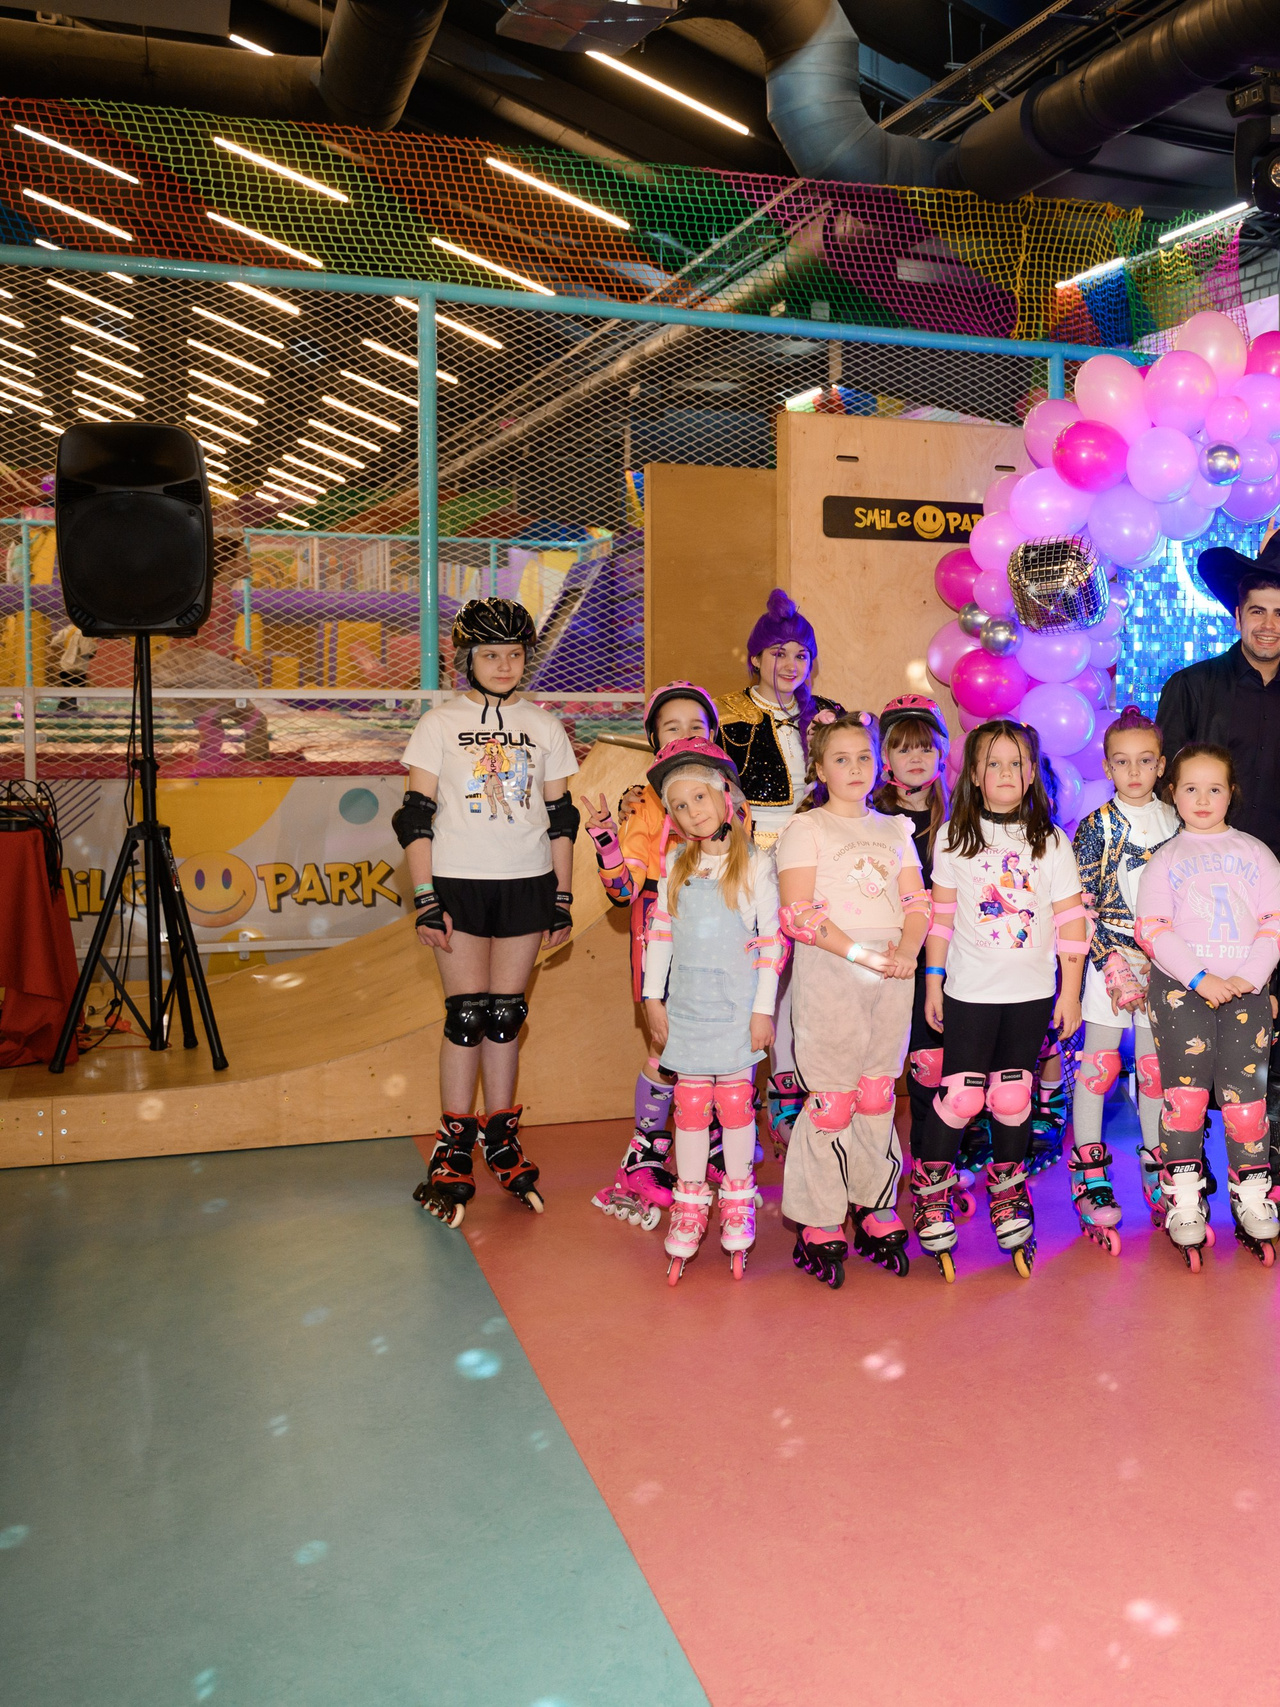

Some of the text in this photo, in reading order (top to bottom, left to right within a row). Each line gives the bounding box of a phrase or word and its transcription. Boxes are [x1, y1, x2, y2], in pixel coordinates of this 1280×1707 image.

[946, 511, 983, 534] PA
[833, 842, 856, 861] CHOOSE
[1169, 854, 1260, 890] AWESOME
[256, 860, 402, 912] PARK
[1188, 944, 1214, 958] RL
